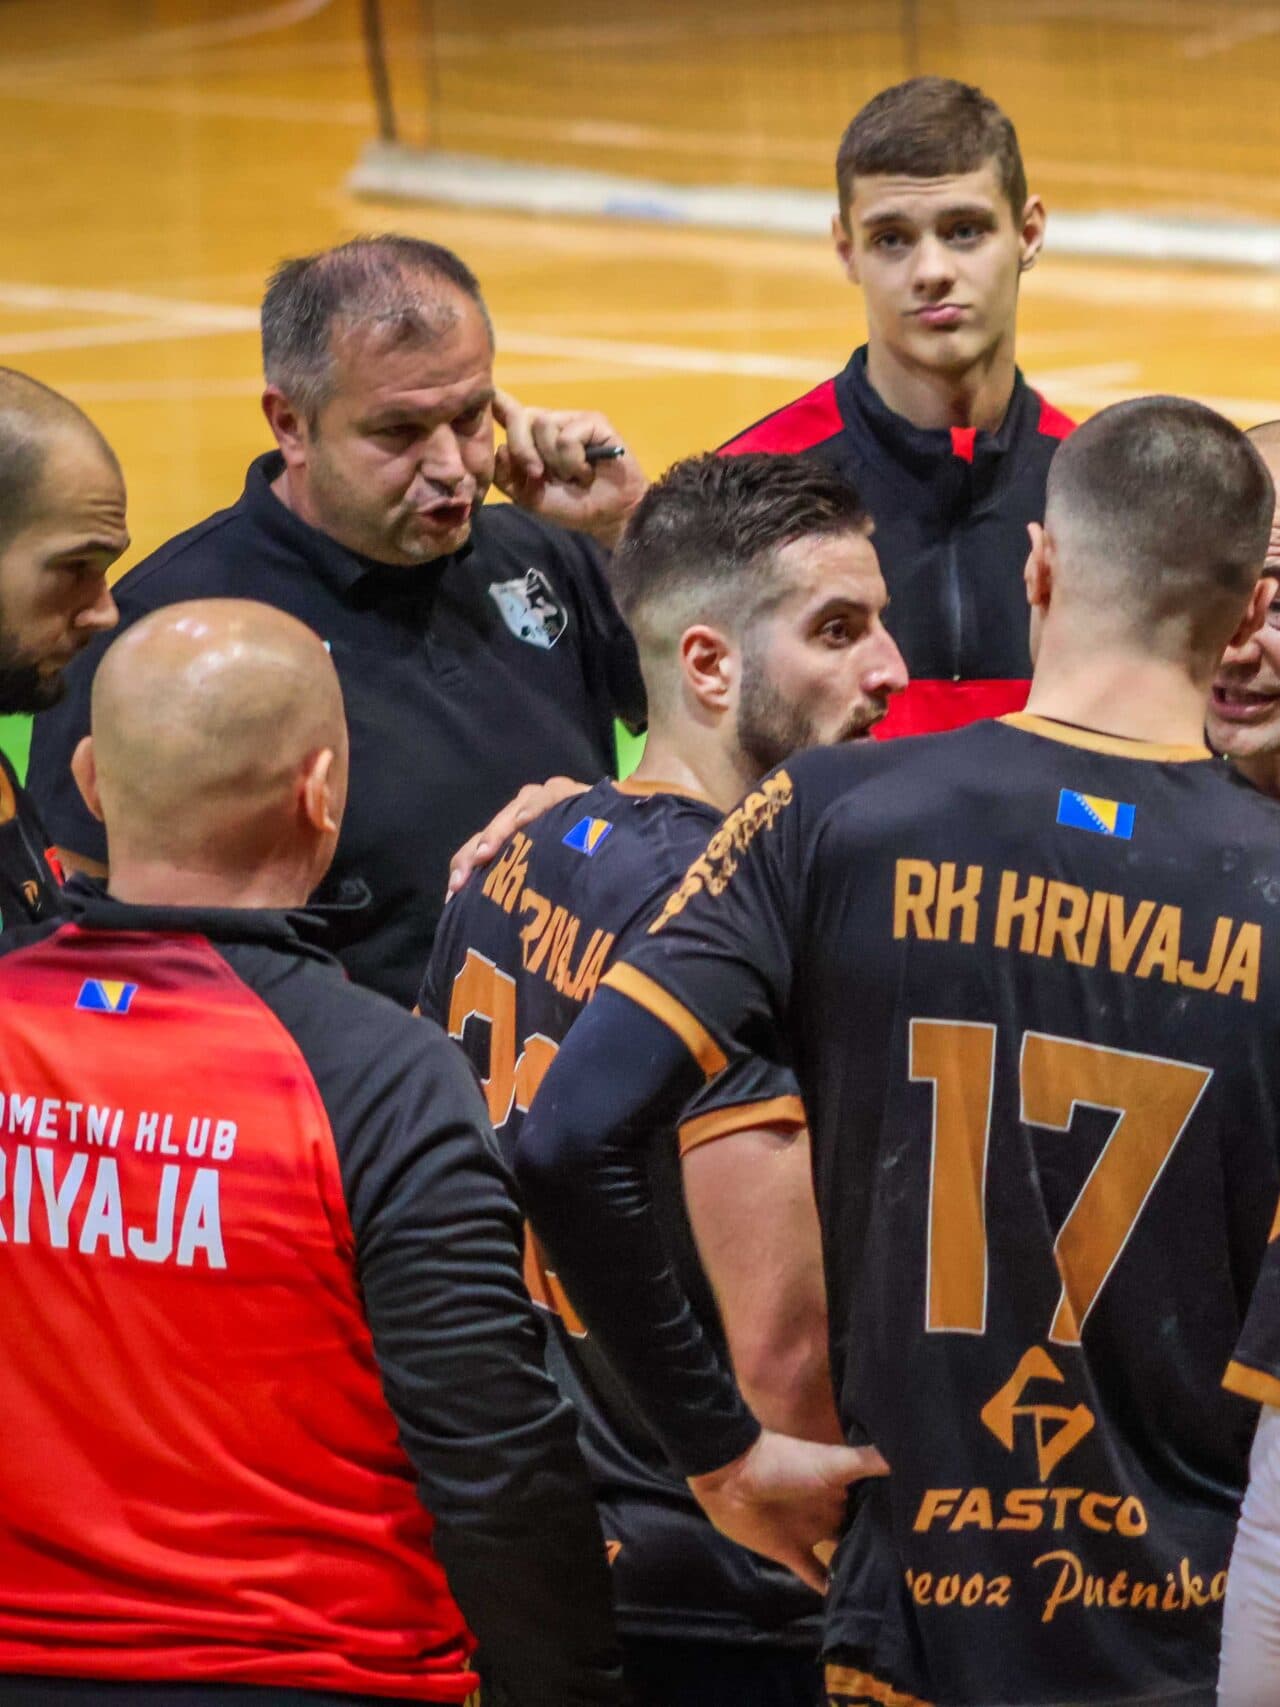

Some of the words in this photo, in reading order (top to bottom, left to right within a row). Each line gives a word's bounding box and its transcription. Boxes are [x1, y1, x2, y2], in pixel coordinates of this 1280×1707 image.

[894, 859, 982, 940] RK
[995, 869, 1263, 1002] KRIVAJA
[0, 1091, 124, 1148] METNI
[134, 1111, 237, 1161] KLUB
[909, 1017, 1214, 1346] 17
[913, 1487, 1148, 1537] FASTCO
